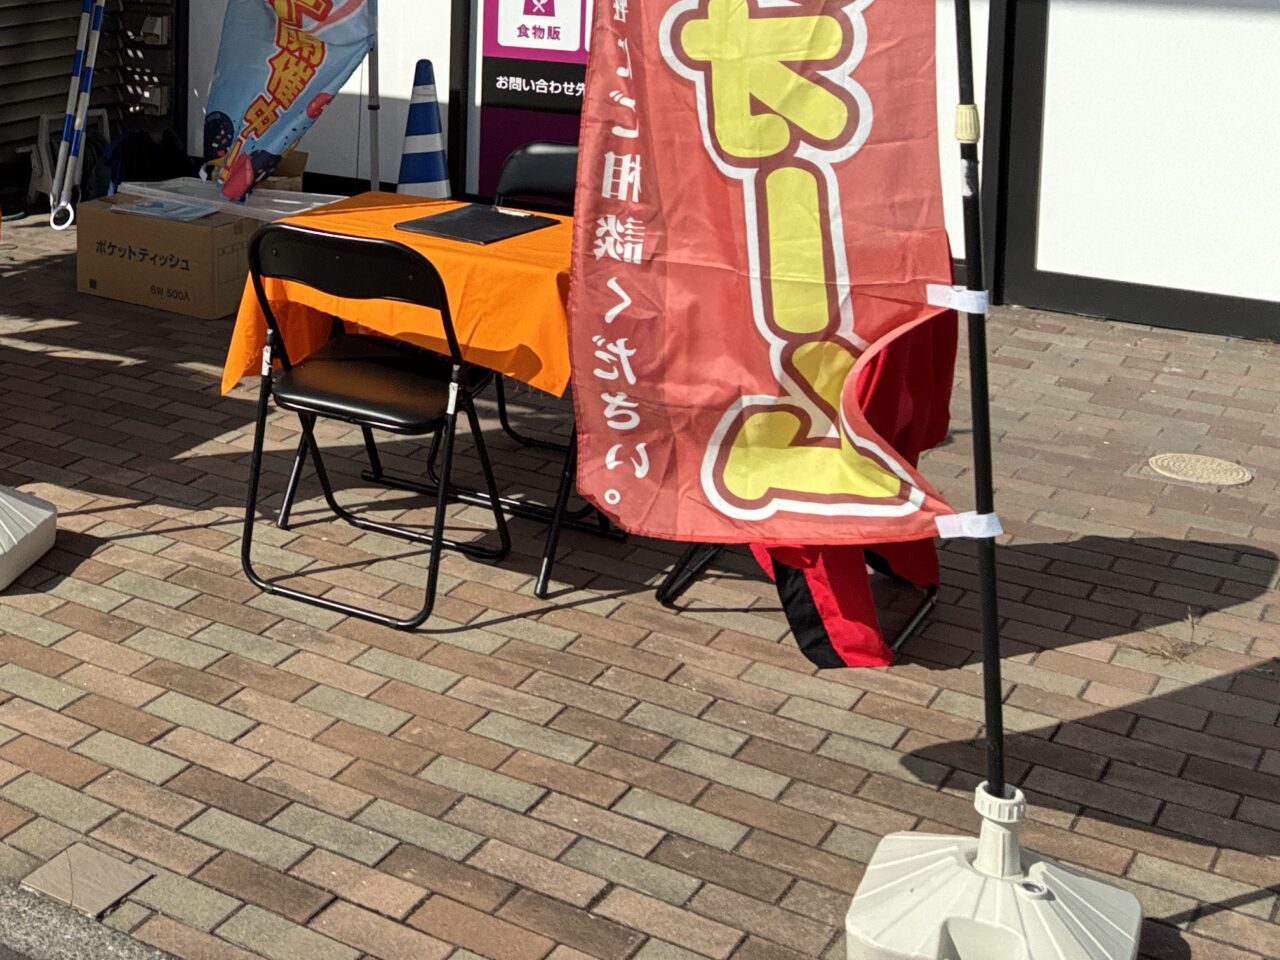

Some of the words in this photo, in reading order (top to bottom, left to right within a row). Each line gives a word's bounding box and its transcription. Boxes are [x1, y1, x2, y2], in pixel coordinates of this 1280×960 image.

[517, 23, 561, 41] 食物販
[96, 239, 191, 271] ポケットティッシュ
